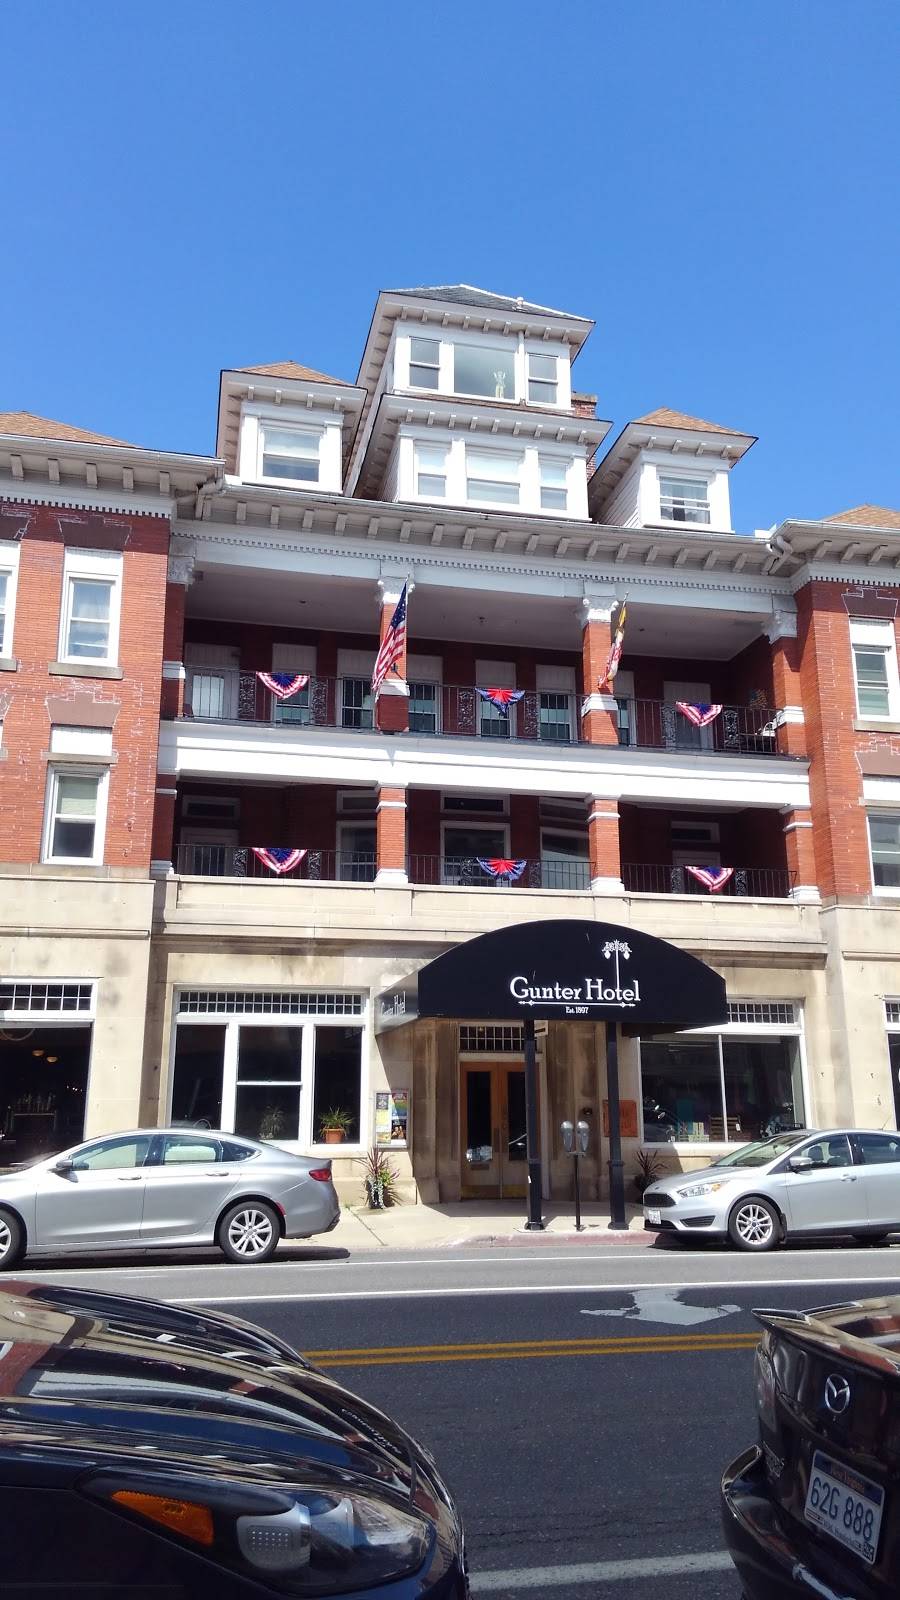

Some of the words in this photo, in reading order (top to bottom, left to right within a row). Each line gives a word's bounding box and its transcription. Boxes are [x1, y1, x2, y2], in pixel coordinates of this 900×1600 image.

[509, 976, 582, 1000] Gunter
[585, 978, 641, 1002] Hotel
[575, 1006, 589, 1014] 1897
[811, 1477, 840, 1520] 62G
[843, 1496, 874, 1542] 888
